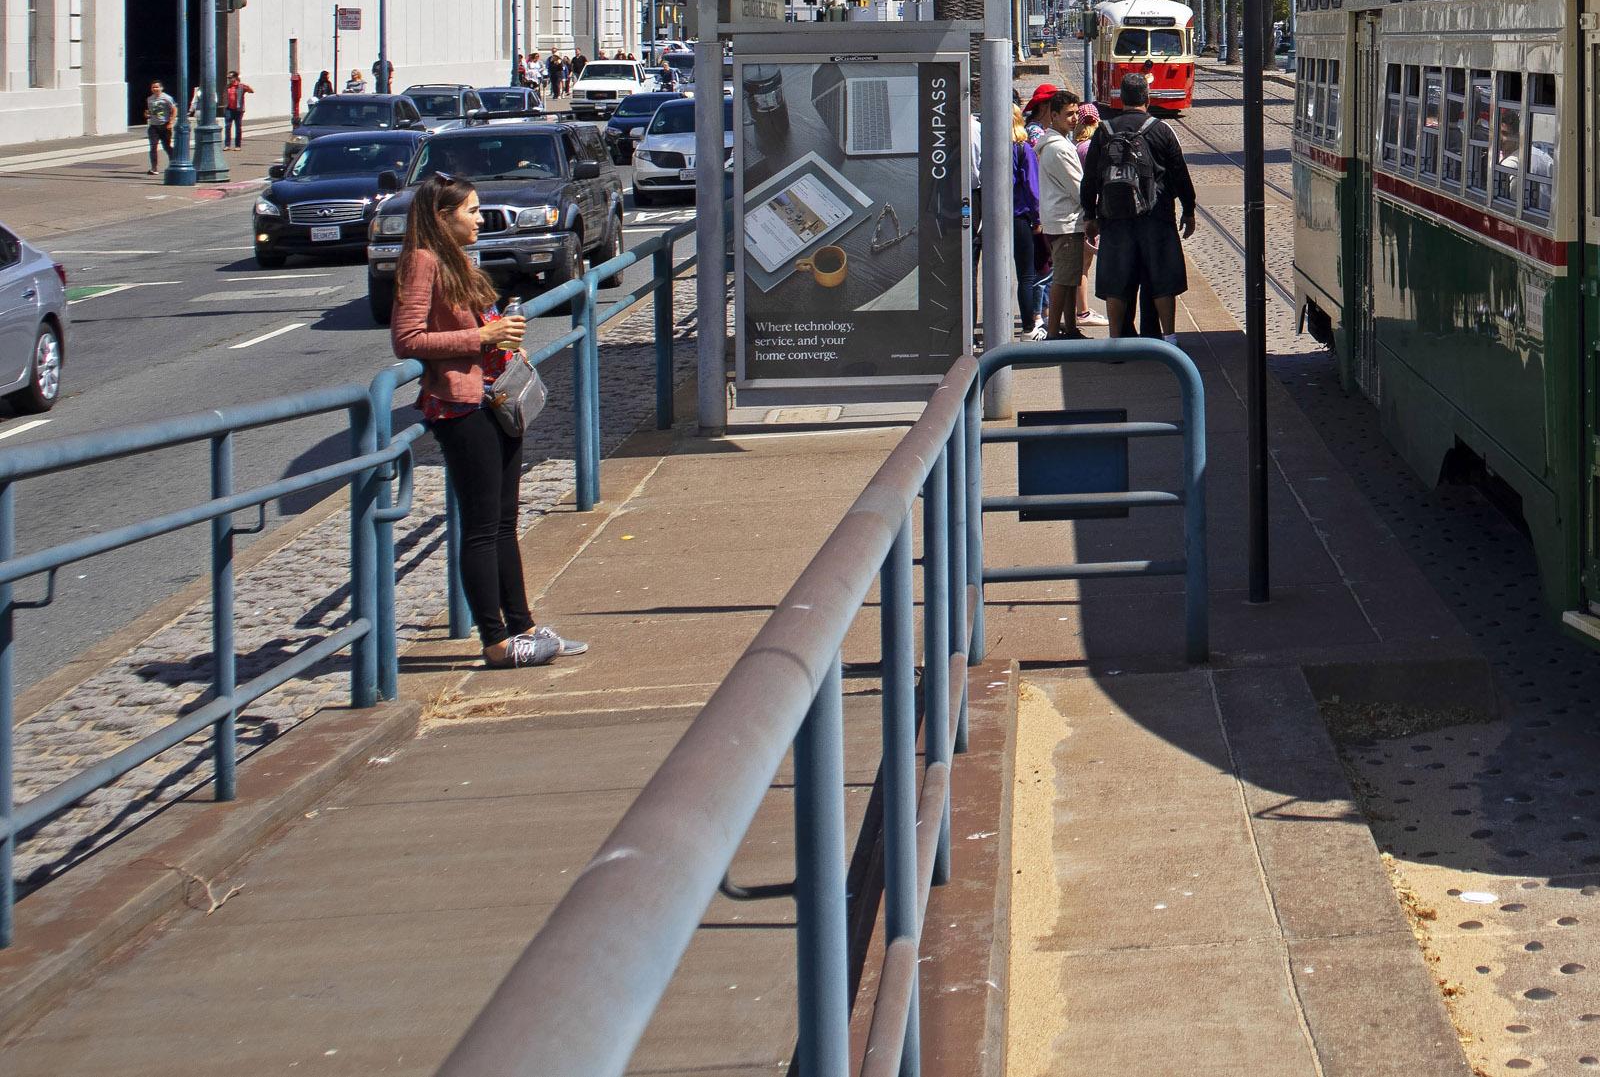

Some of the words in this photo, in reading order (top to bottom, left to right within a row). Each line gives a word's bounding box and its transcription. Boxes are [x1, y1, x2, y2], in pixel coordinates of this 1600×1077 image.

[931, 78, 947, 179] COMPASS
[755, 322, 792, 332] Where
[755, 336, 795, 346] service,
[797, 335, 818, 345] and
[820, 337, 846, 347] your
[755, 351, 786, 361] home
[788, 351, 838, 362] converge.
